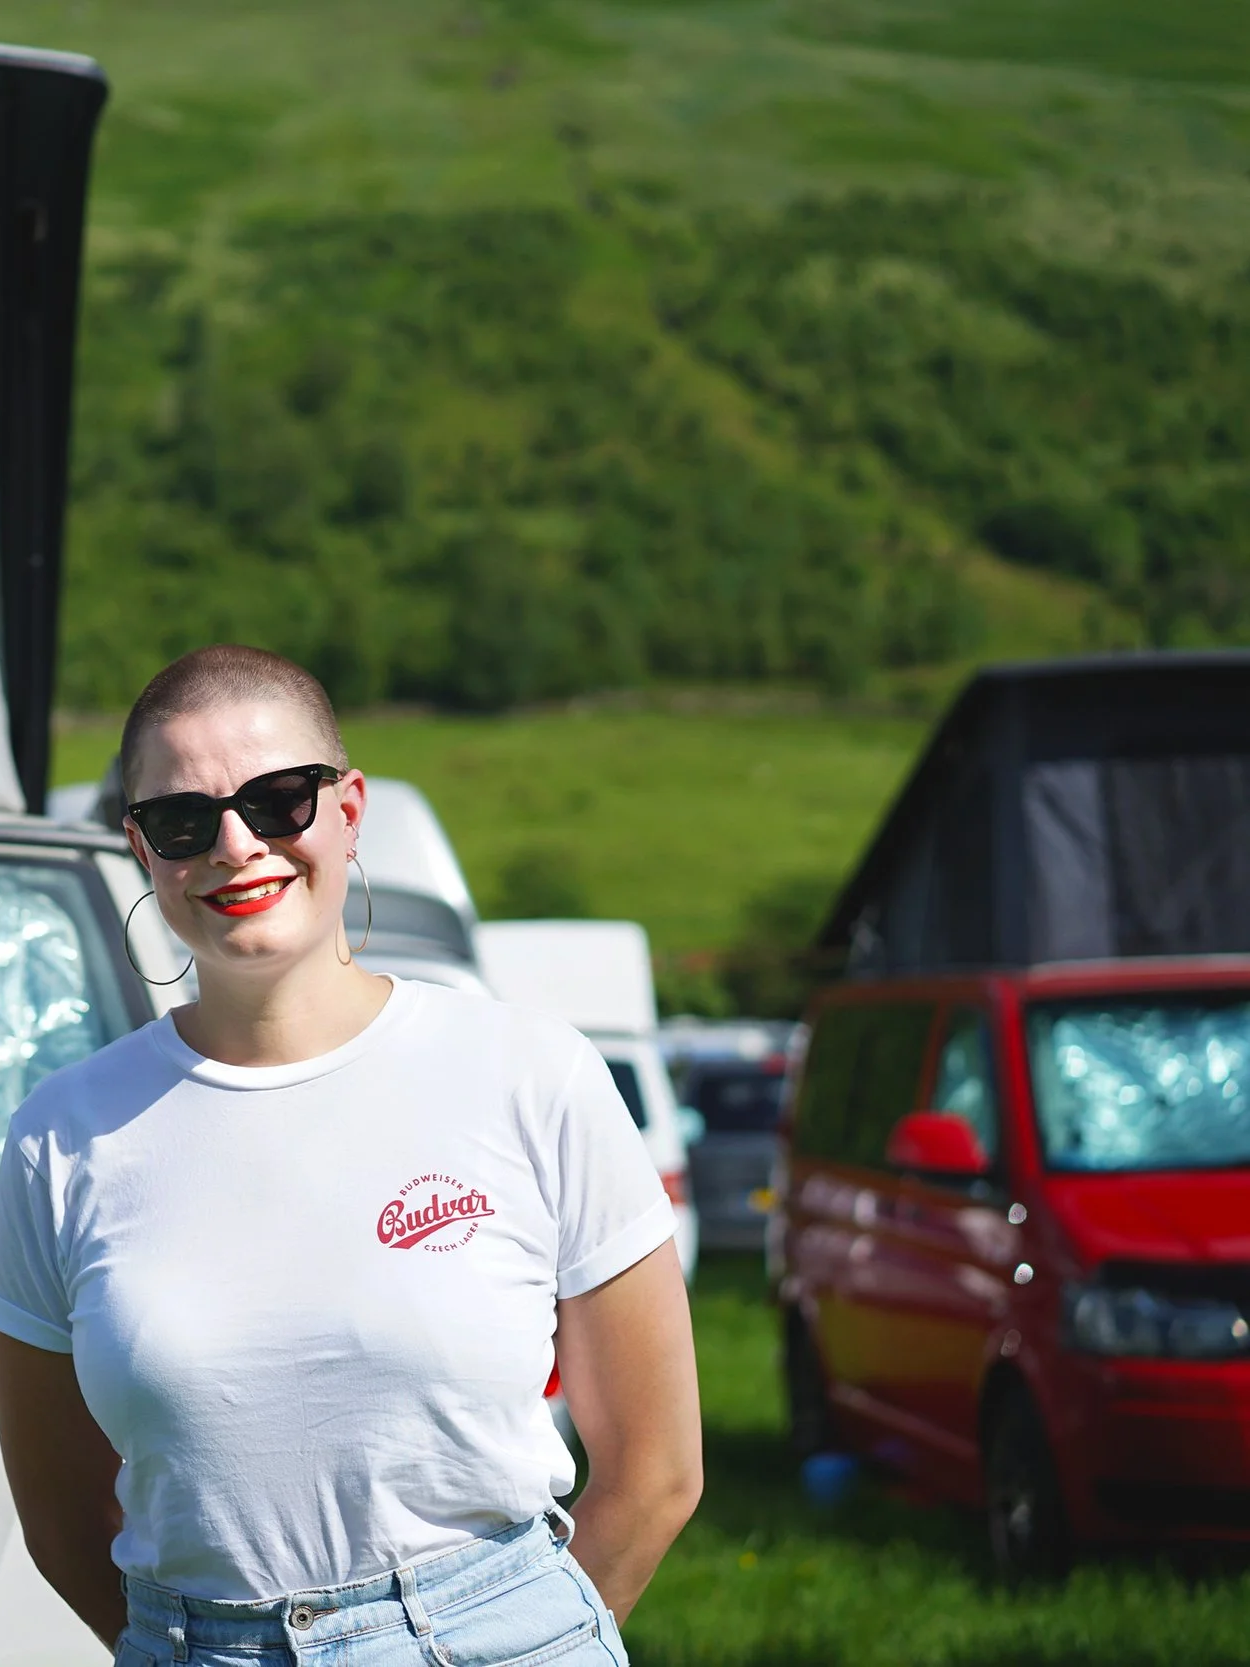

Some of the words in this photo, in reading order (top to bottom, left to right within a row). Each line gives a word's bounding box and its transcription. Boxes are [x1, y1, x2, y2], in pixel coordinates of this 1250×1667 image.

[399, 1174, 463, 1196] BUDWEISER
[377, 1189, 495, 1249] Budvar
[424, 1243, 458, 1253] CZECH
[459, 1221, 479, 1246] LAGER
